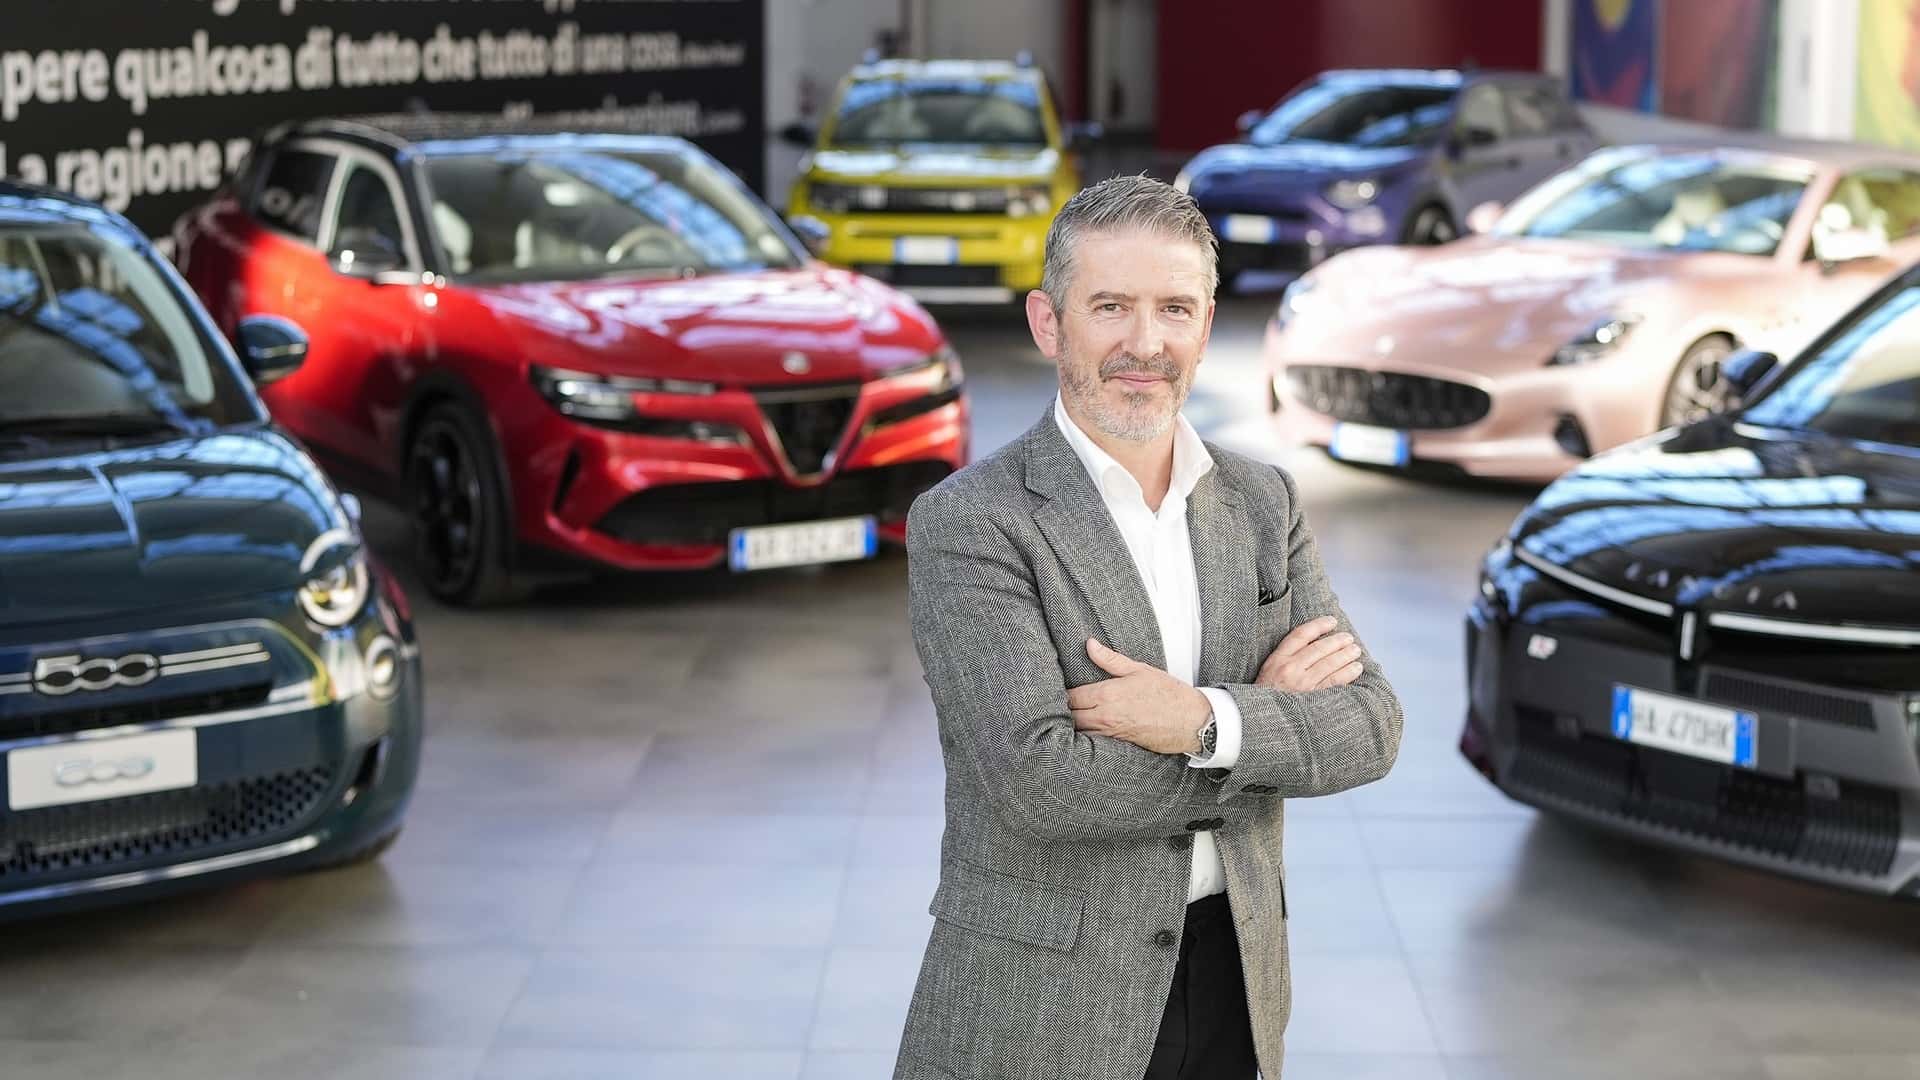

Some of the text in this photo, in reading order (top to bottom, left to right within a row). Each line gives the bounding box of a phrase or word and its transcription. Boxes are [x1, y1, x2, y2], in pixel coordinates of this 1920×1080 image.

[114, 29, 292, 115] qualcosa
[295, 26, 333, 89] di
[336, 32, 420, 87] tutto
[422, 22, 475, 82] che
[477, 28, 548, 77] tutto
[552, 20, 580, 75] di
[55, 128, 221, 212] ragione
[34, 653, 160, 696] 500
